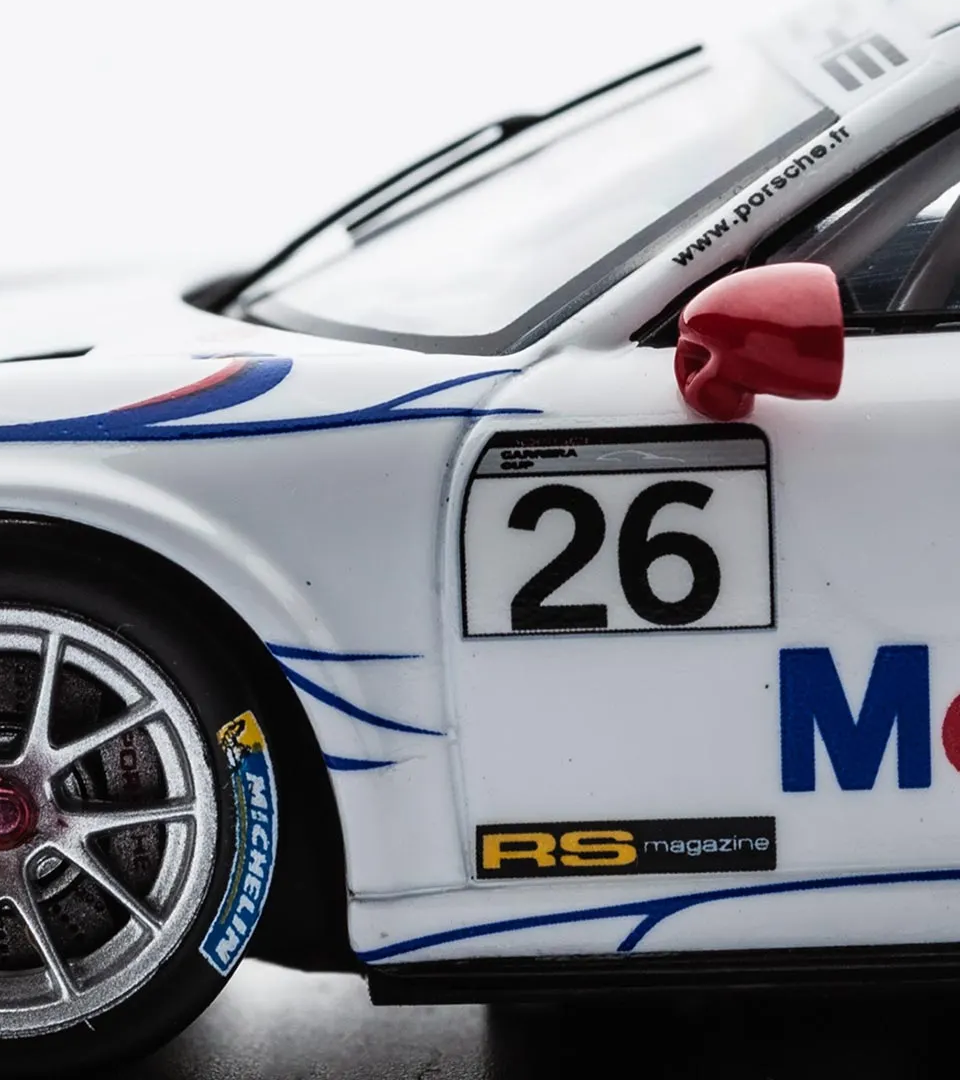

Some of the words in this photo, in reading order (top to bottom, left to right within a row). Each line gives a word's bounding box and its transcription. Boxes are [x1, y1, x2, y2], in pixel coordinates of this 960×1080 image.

[672, 125, 850, 266] www.porsche.fr
[508, 480, 721, 631] 26
[779, 644, 960, 792] M
[214, 771, 271, 965] MICHELIN
[482, 830, 638, 870] RS
[643, 835, 771, 857] magazine
